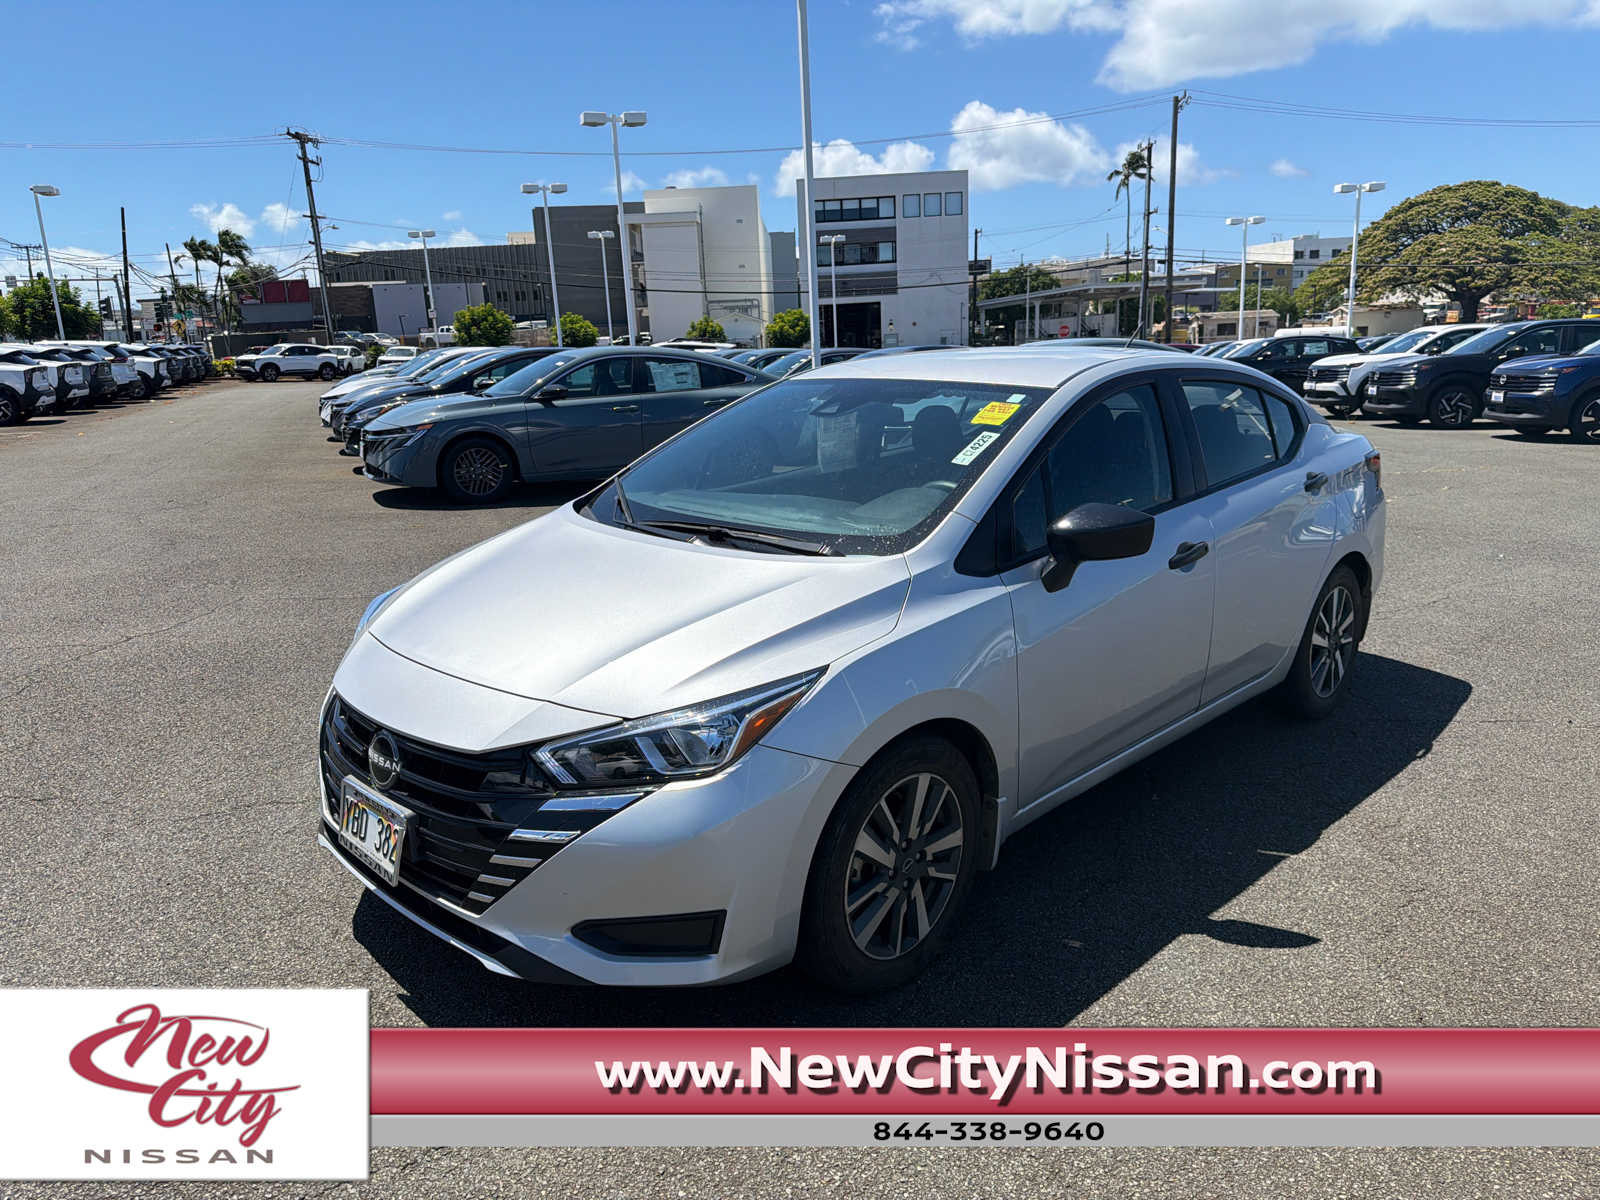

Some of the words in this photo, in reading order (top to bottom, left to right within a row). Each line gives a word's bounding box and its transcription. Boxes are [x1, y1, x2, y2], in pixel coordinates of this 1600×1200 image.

[368, 749, 401, 772] NISSAN
[344, 796, 369, 843] YBD
[374, 817, 400, 865] 382
[340, 836, 393, 882] NISSAN
